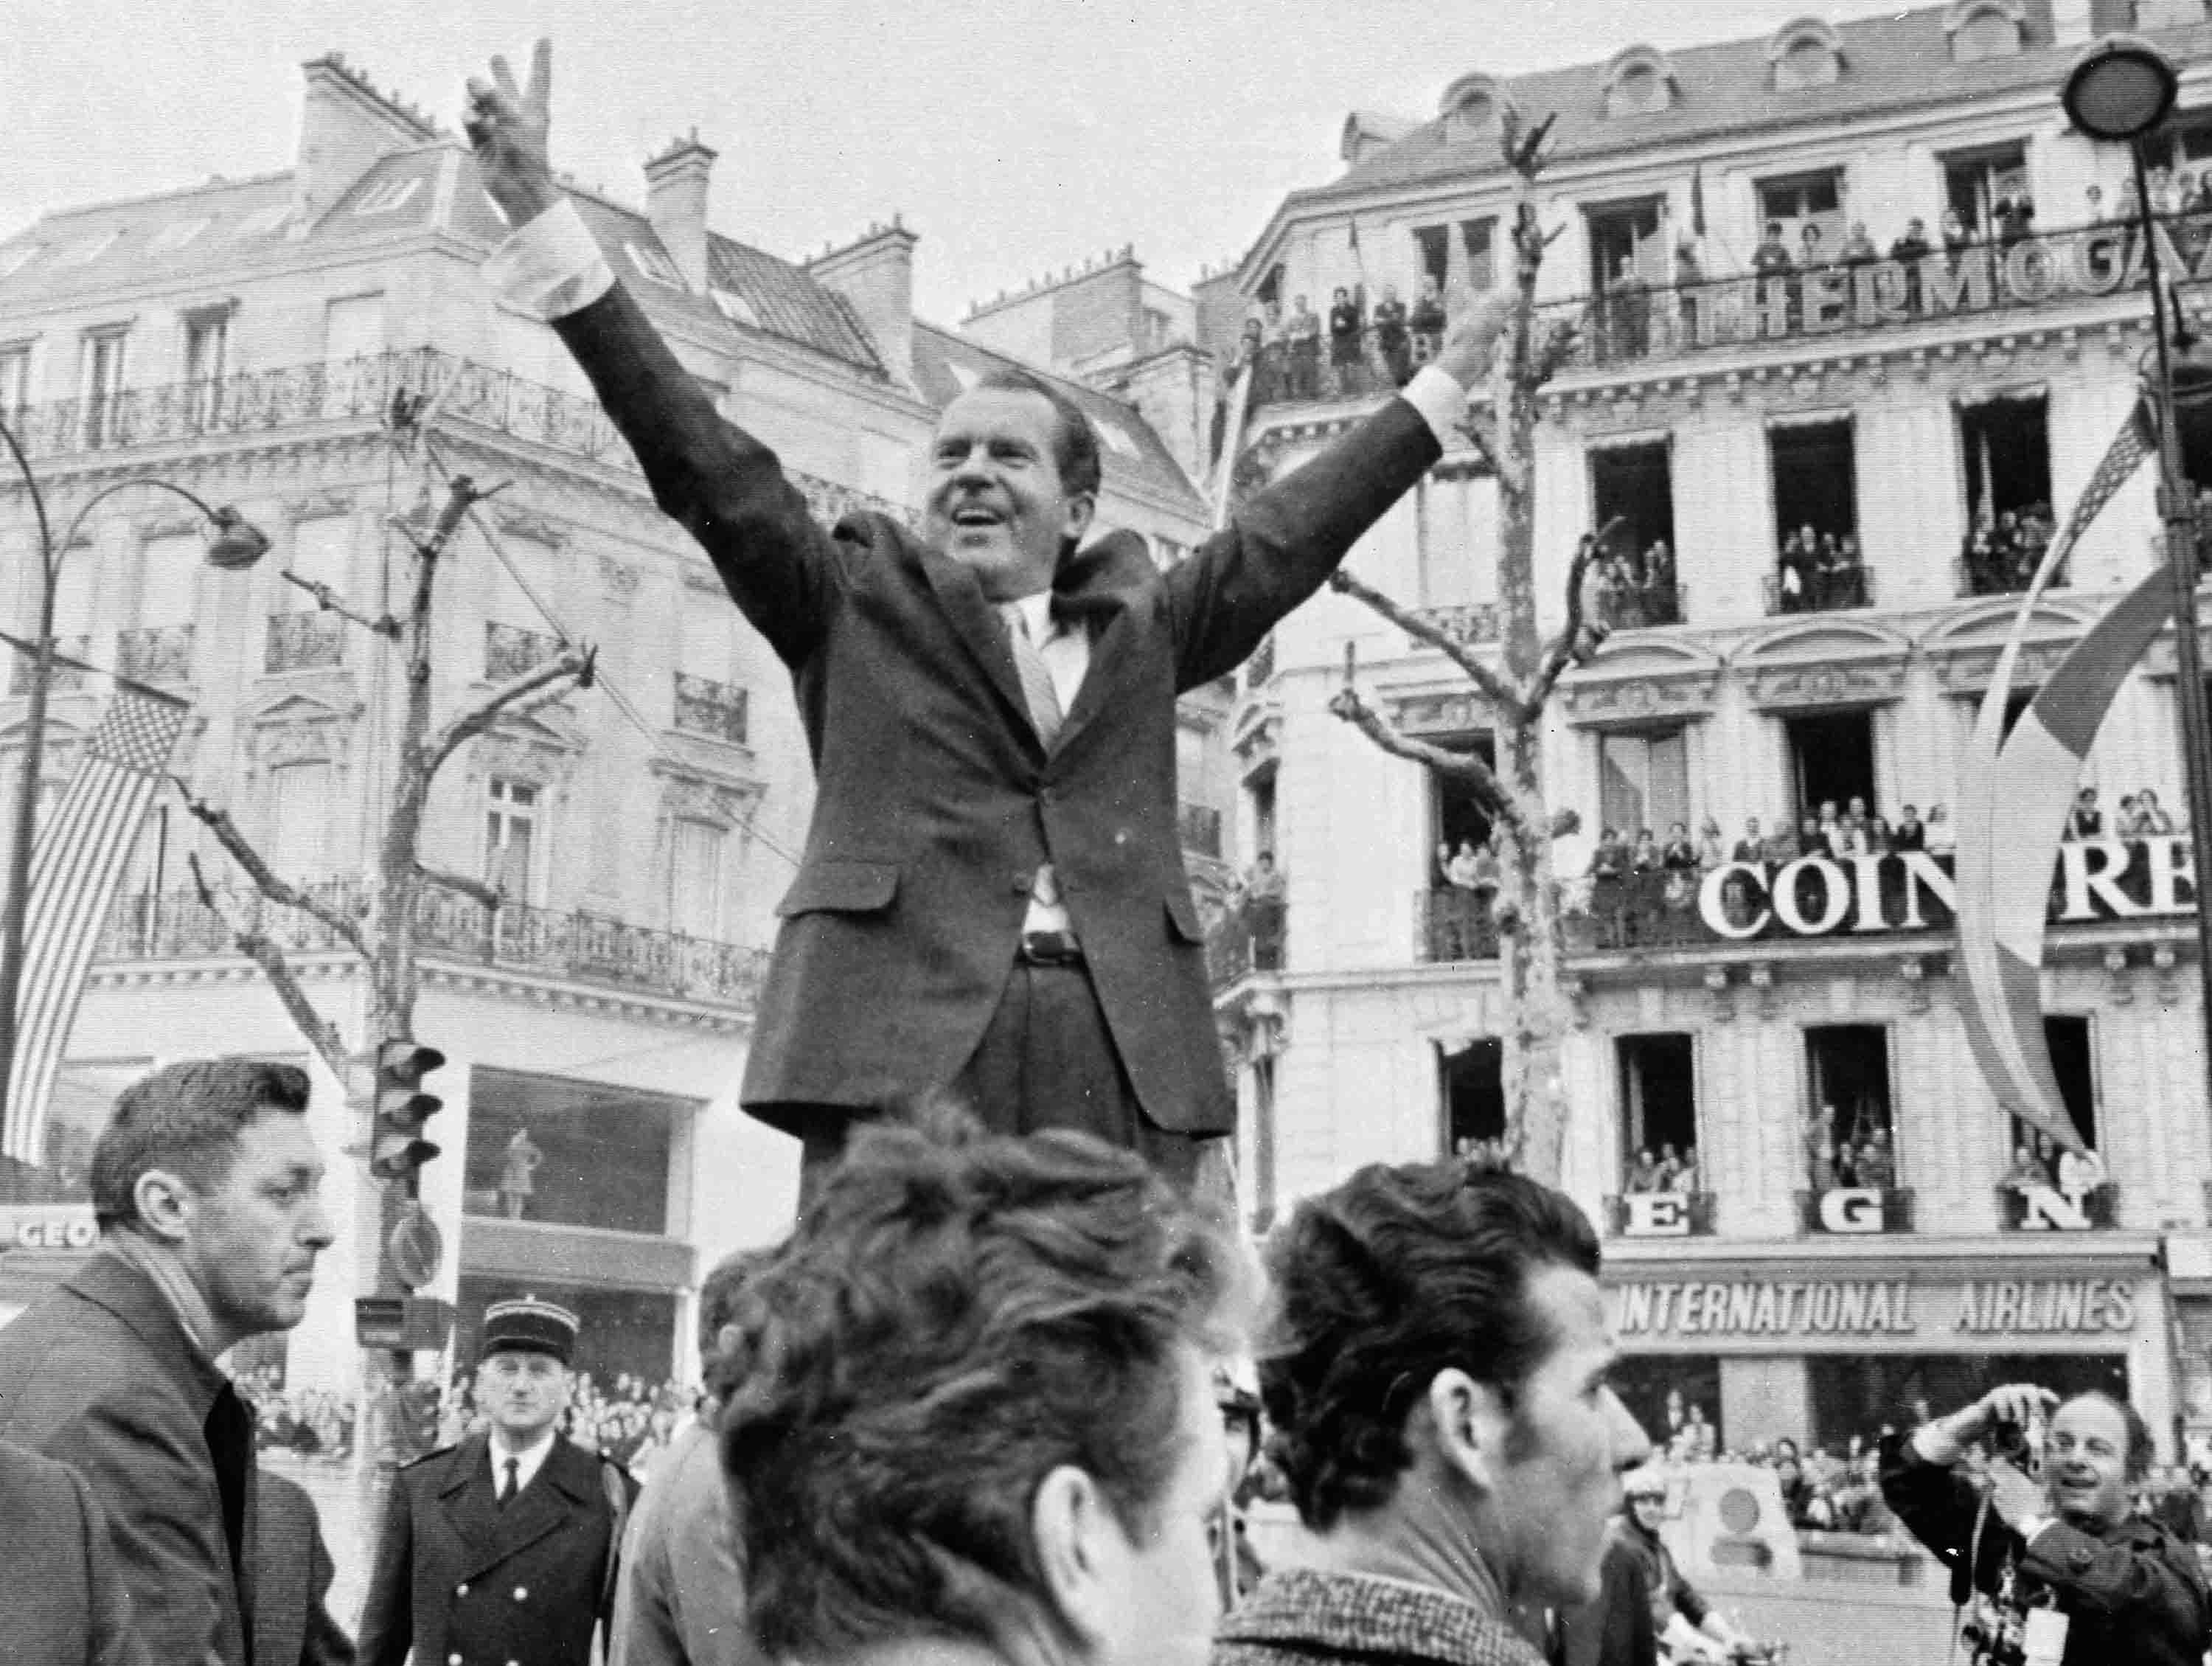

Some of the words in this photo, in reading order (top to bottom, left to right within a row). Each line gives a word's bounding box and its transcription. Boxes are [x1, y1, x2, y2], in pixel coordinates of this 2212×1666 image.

[1678, 218, 2212, 344] THERMOGA
[1697, 836, 2198, 939] COINRE
[1617, 1282, 1916, 1334] INTERNATIONAL
[1954, 1279, 2137, 1332] AIRLINES
